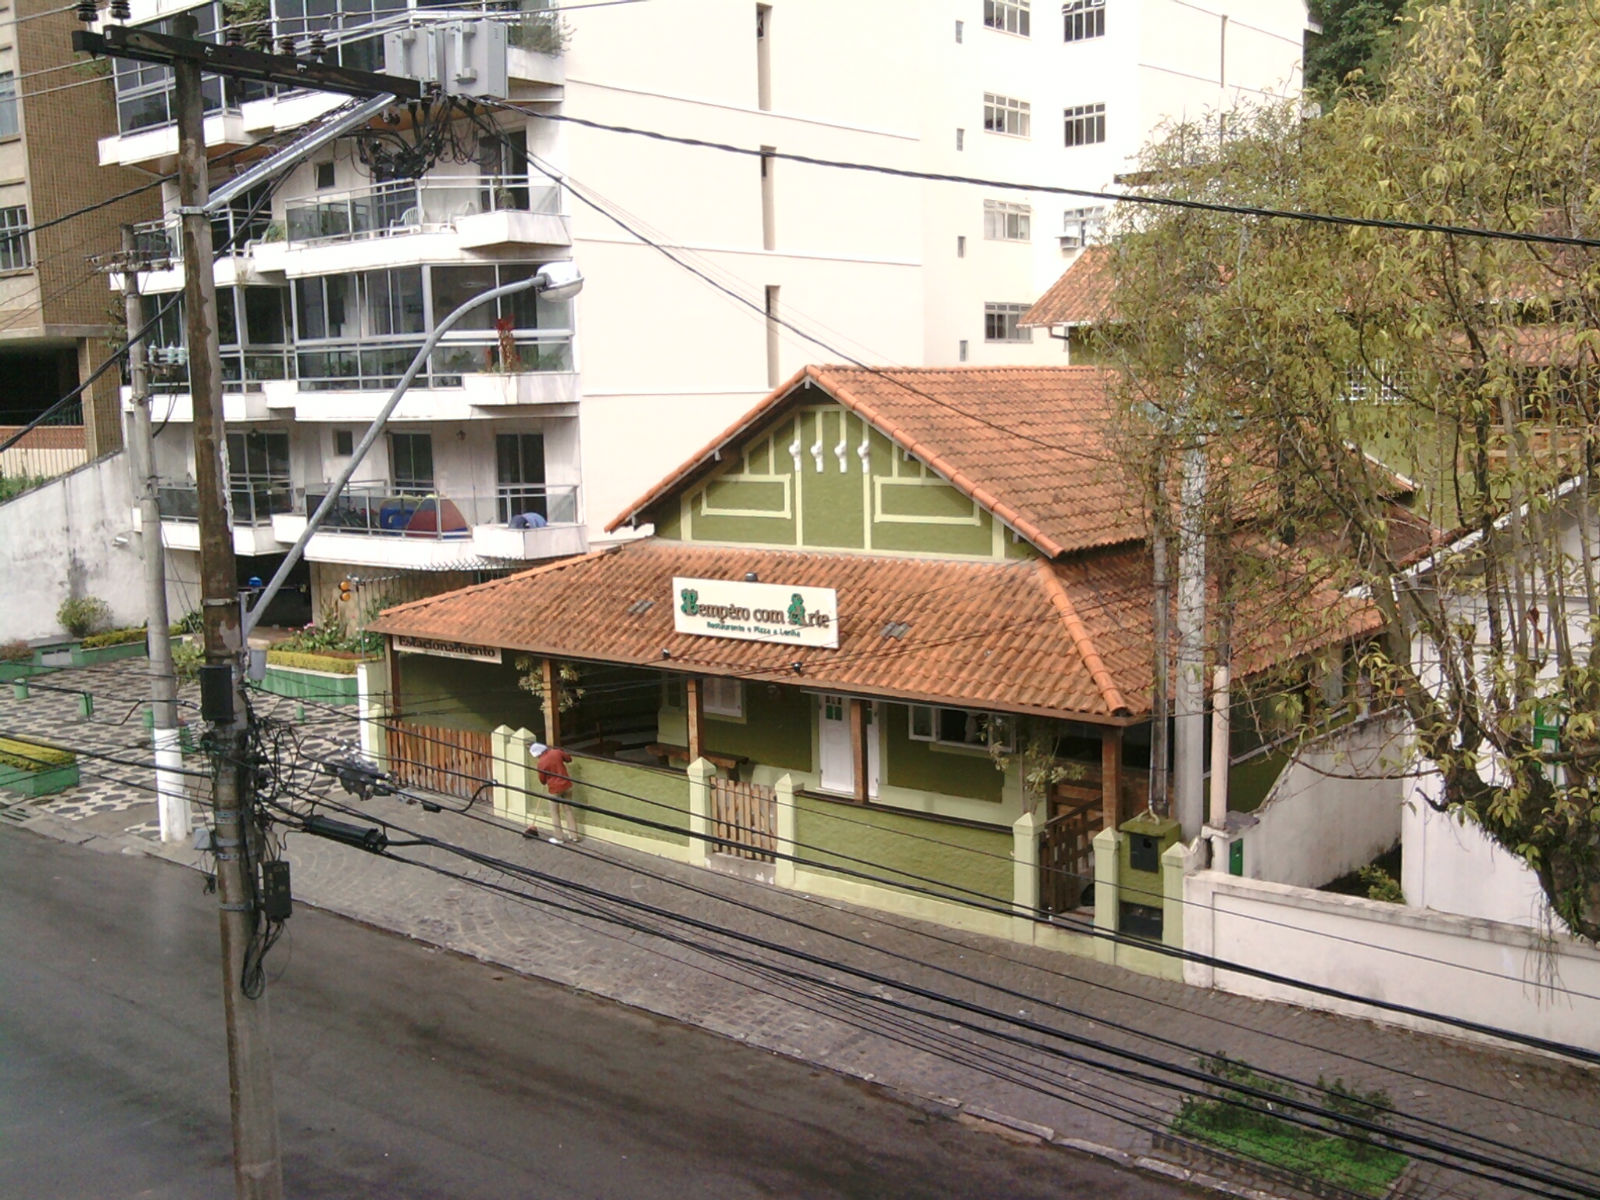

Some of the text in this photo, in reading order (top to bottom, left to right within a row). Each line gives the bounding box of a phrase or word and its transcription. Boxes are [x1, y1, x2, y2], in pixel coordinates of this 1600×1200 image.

[753, 608, 785, 624] com
[787, 593, 830, 628] Arte
[706, 621, 745, 632] Restaurante
[753, 625, 771, 635] Pizza
[779, 627, 801, 638] Lenha
[399, 636, 496, 657] Estacionamento
